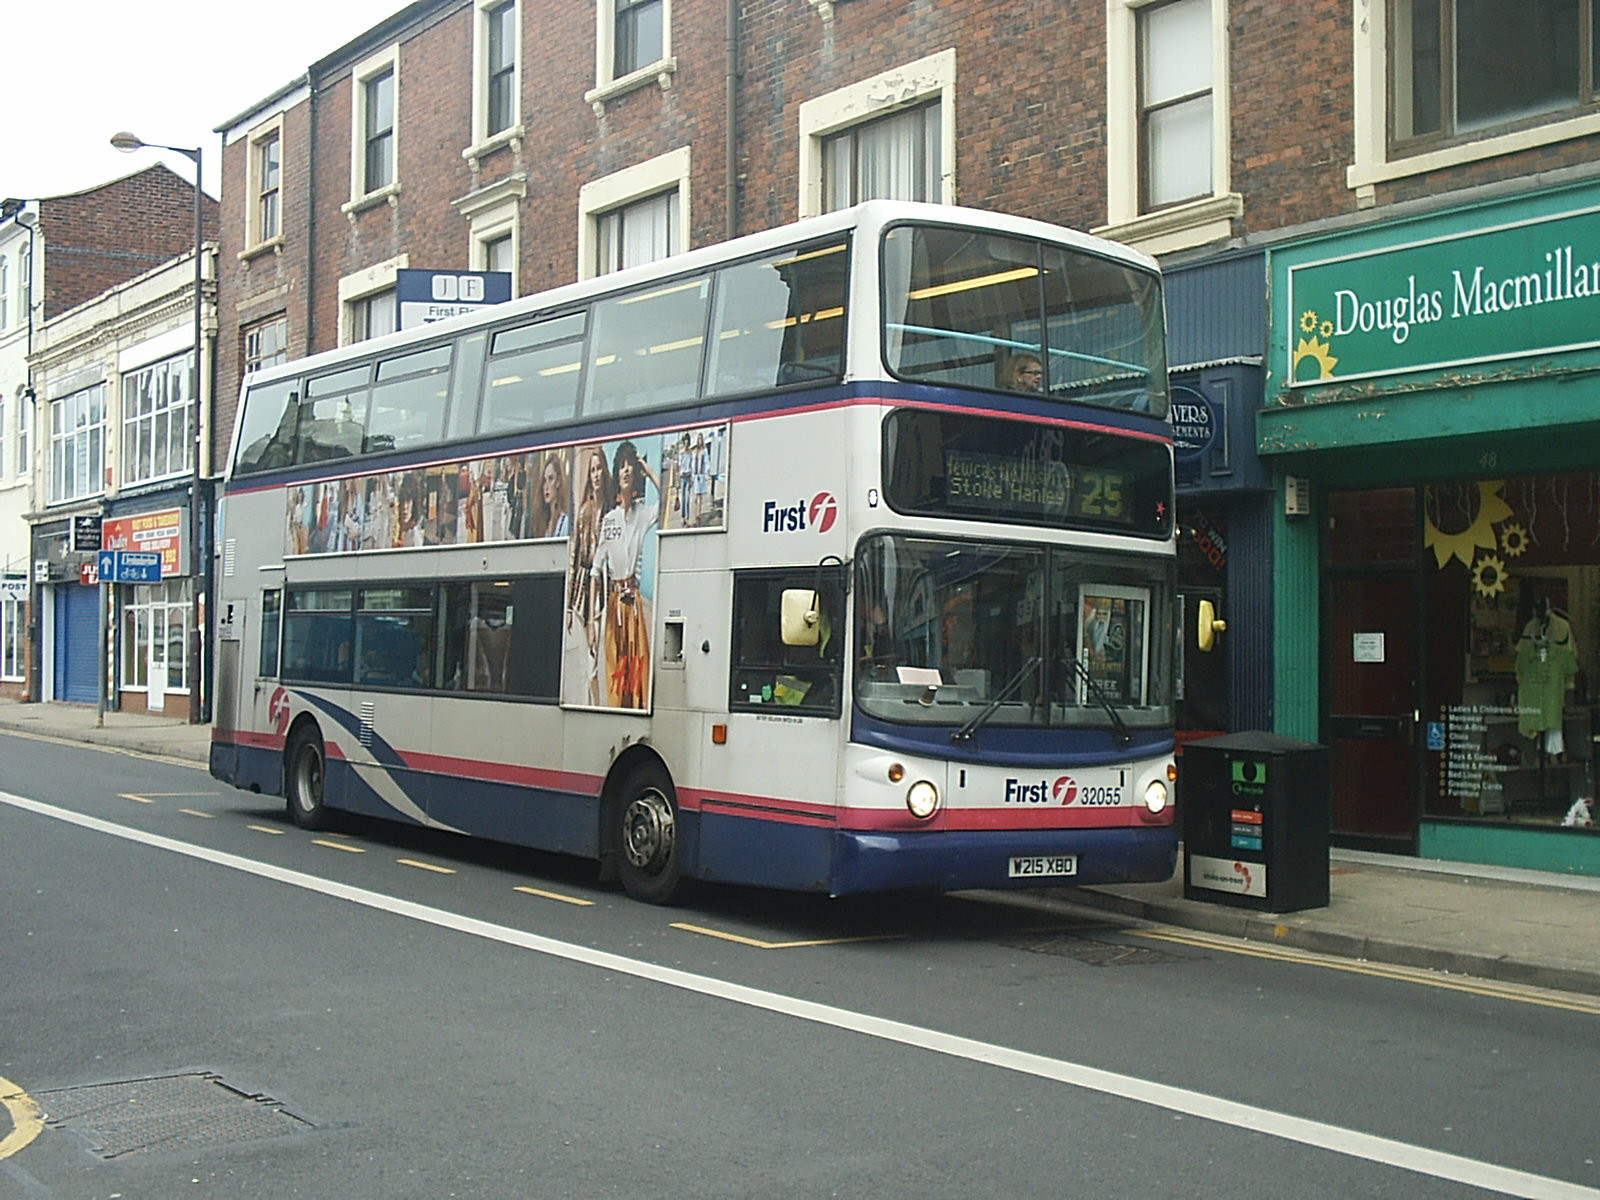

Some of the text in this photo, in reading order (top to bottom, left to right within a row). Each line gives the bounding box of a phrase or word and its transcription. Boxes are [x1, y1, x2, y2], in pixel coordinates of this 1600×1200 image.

[429, 305, 455, 317] First
[1333, 275, 1443, 344] Douglas
[1172, 404, 1209, 424] VERS
[950, 476, 1066, 506] Stoke Hanley
[1080, 471, 1124, 517] 25
[763, 499, 807, 533] First
[1004, 778, 1121, 806] First 32055
[1013, 858, 1073, 875] W215 XBD
